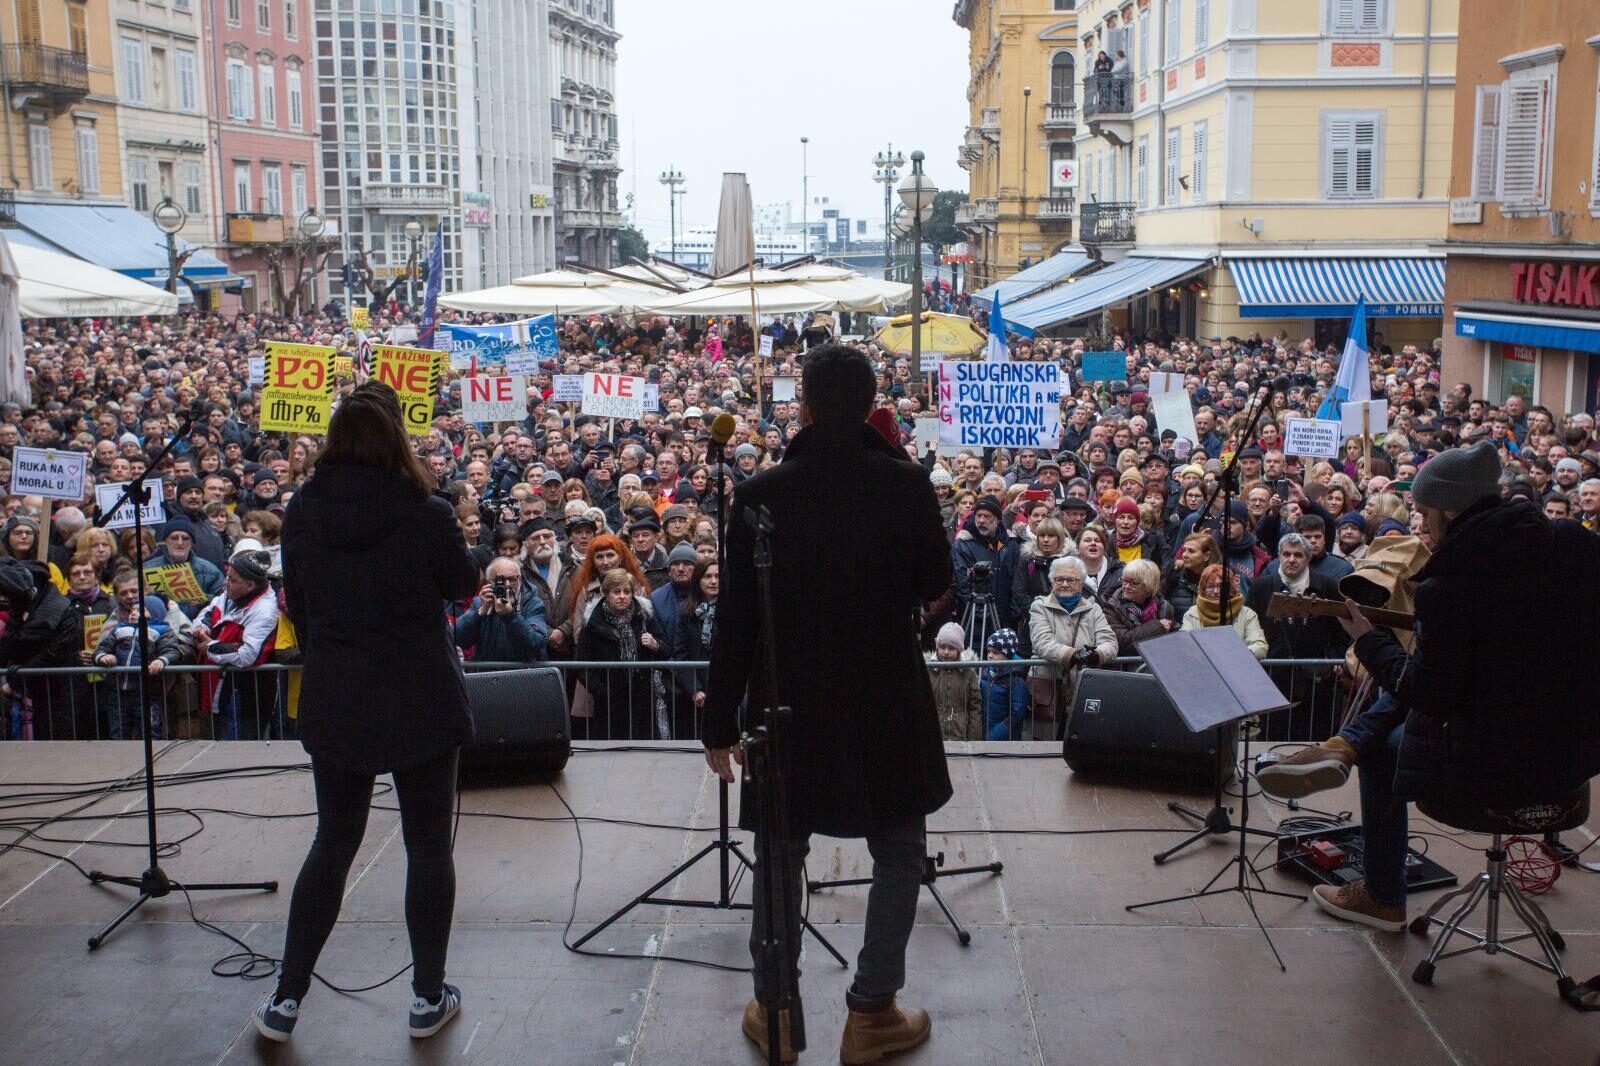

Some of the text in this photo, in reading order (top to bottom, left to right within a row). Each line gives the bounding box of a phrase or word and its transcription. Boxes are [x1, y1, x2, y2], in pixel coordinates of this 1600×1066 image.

[1510, 263, 1599, 306] TISAK
[1462, 324, 1476, 334] TISAK
[382, 350, 431, 363] MI KAŽEMO
[1514, 347, 1533, 360] TISAK
[379, 362, 430, 393] NE
[957, 362, 1057, 383] SLUGANSKA
[470, 377, 513, 402] NE
[593, 374, 634, 397] NE
[959, 383, 1060, 404] POLITIKA A NE
[20, 461, 64, 474] RUKA NA
[18, 477, 64, 489] MORAL U
[125, 507, 150, 520] MST
[145, 571, 165, 593] LN
[165, 571, 194, 600] NE
